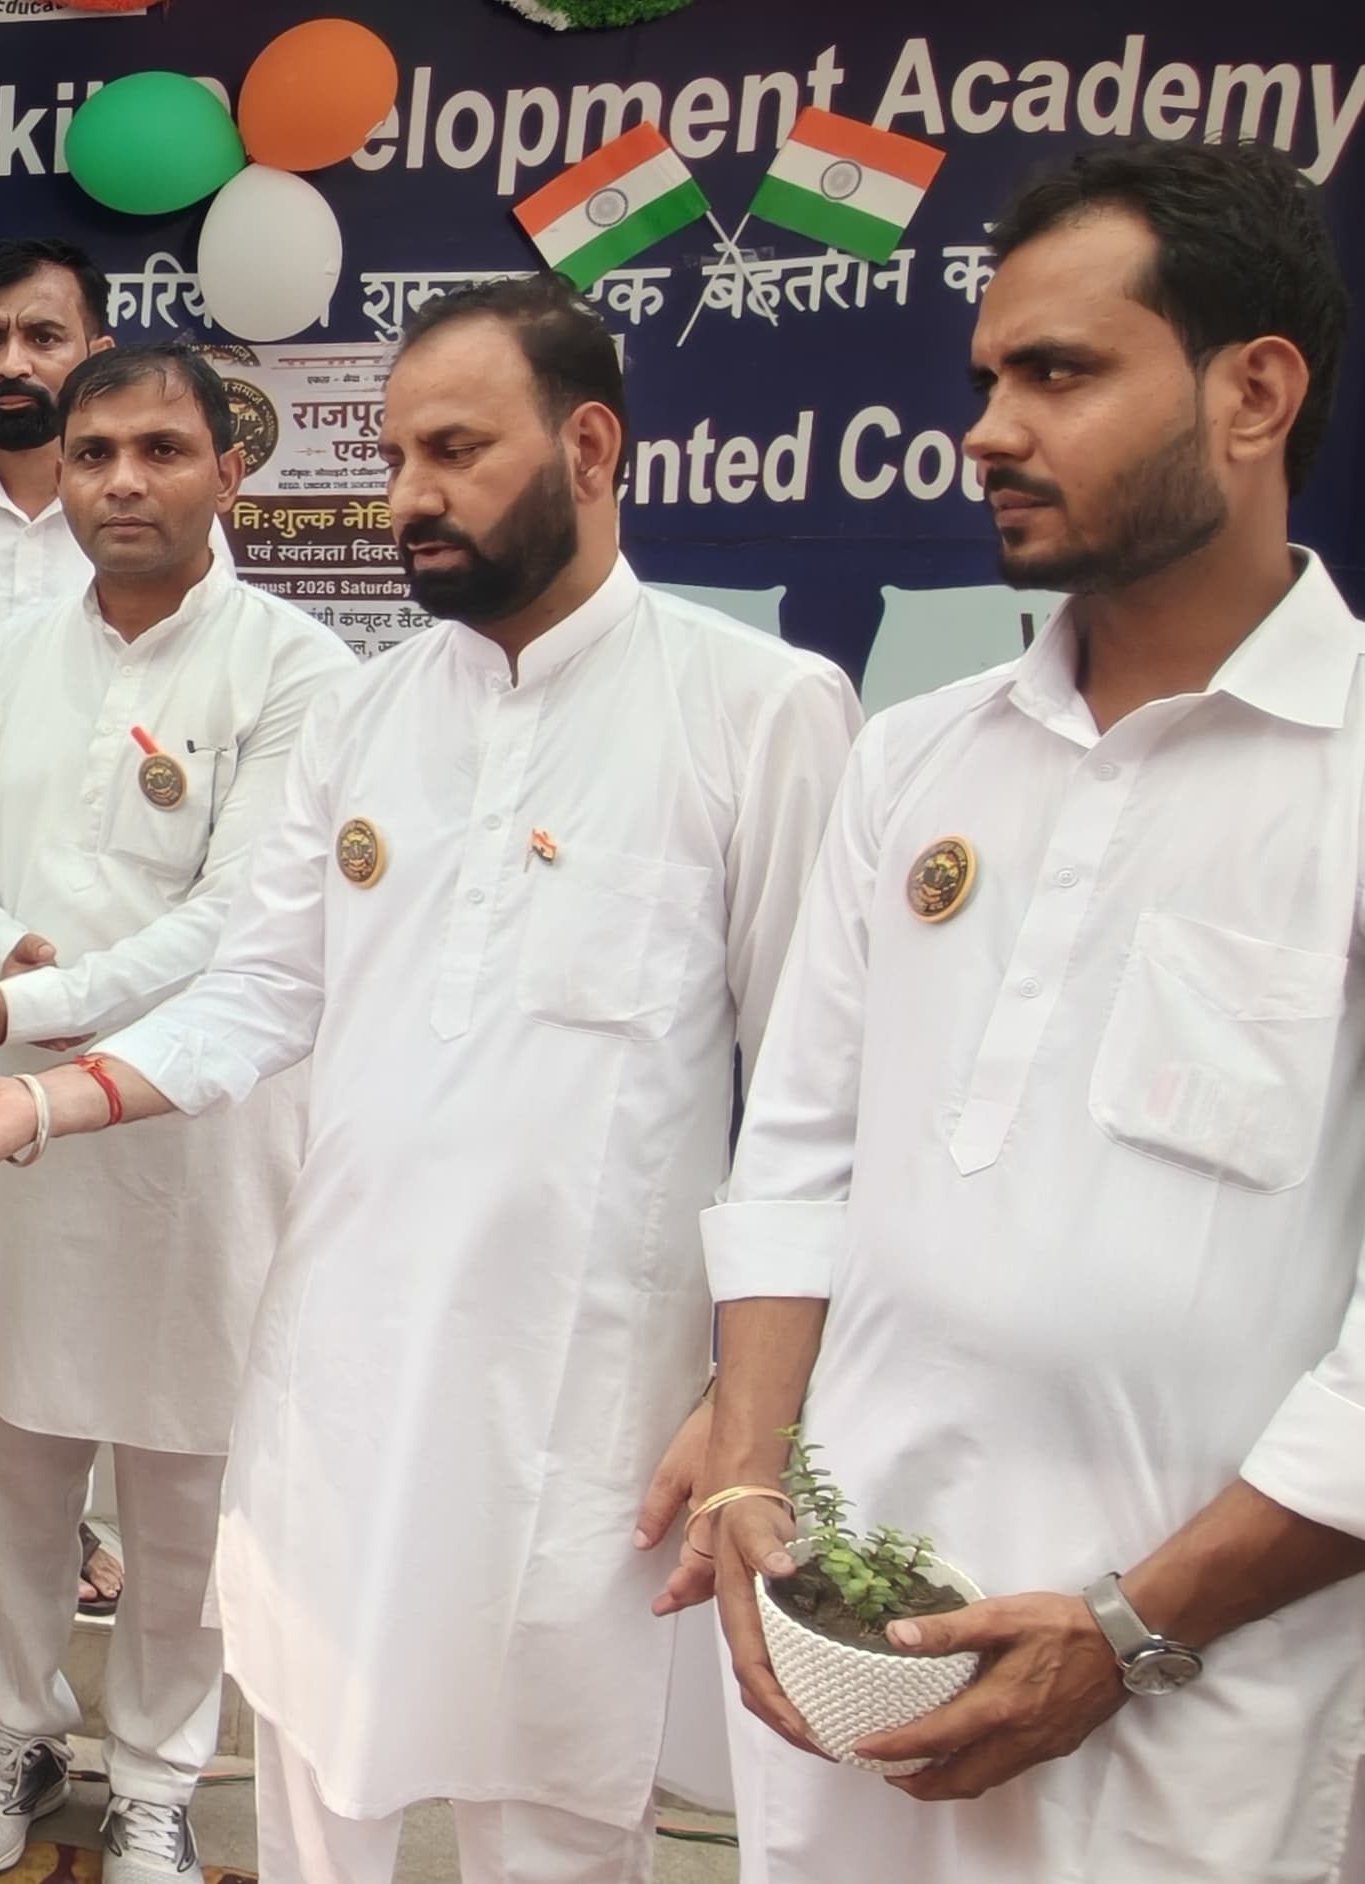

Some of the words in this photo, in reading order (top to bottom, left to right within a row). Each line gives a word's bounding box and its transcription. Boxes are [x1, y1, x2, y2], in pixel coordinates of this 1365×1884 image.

[191, 45, 845, 196] lopment
[870, 34, 1365, 187] Academy
[332, 440, 381, 462] एक
[616, 410, 815, 505] nted
[247, 539, 272, 562] एवं
[351, 538, 400, 562] दिवस
[245, 580, 292, 595] ugust
[296, 580, 336, 595] 2026
[340, 580, 412, 598] Saturday
